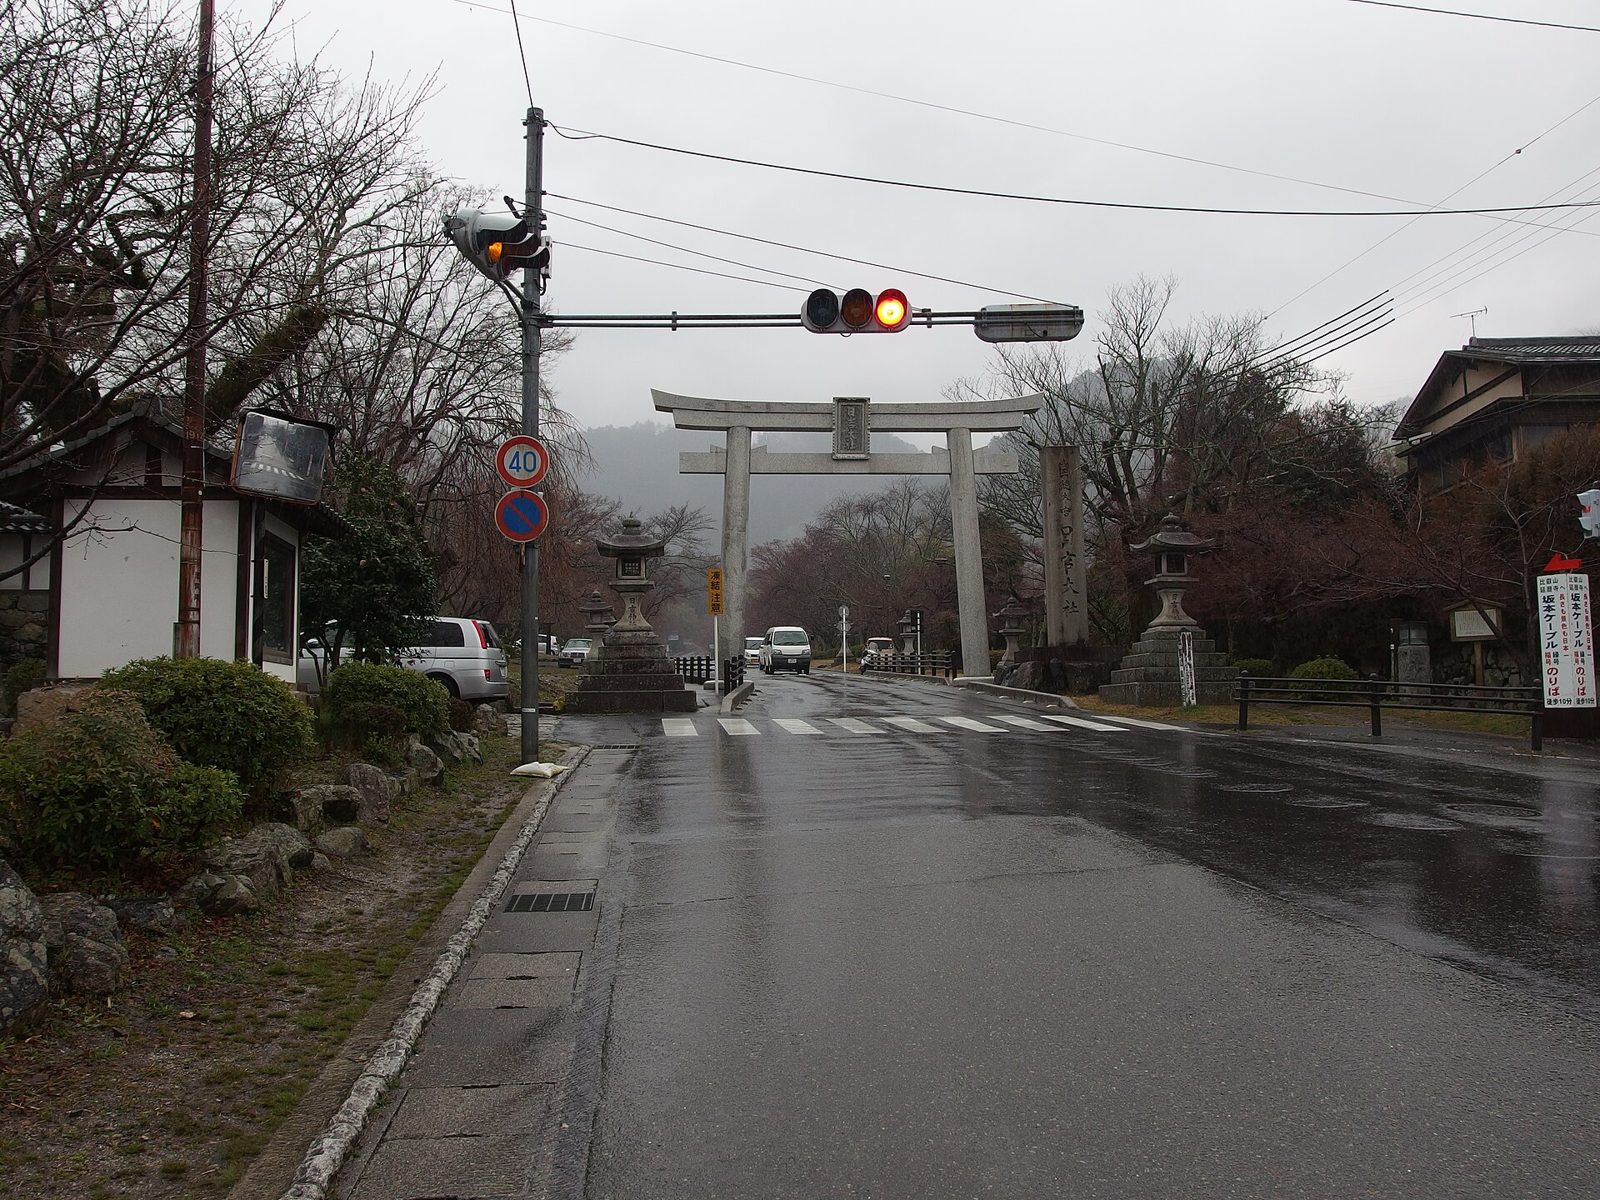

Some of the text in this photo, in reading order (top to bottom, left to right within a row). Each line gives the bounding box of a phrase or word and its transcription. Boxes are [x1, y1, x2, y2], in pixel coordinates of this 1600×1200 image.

[509, 451, 537, 472] 40
[711, 571, 721, 613] 凍結注意
[1542, 594, 1558, 649] 坂本ケーブル
[1571, 592, 1584, 648] 坂本ケーブル
[1547, 667, 1560, 696] のりば
[1576, 666, 1586, 696] のりば
